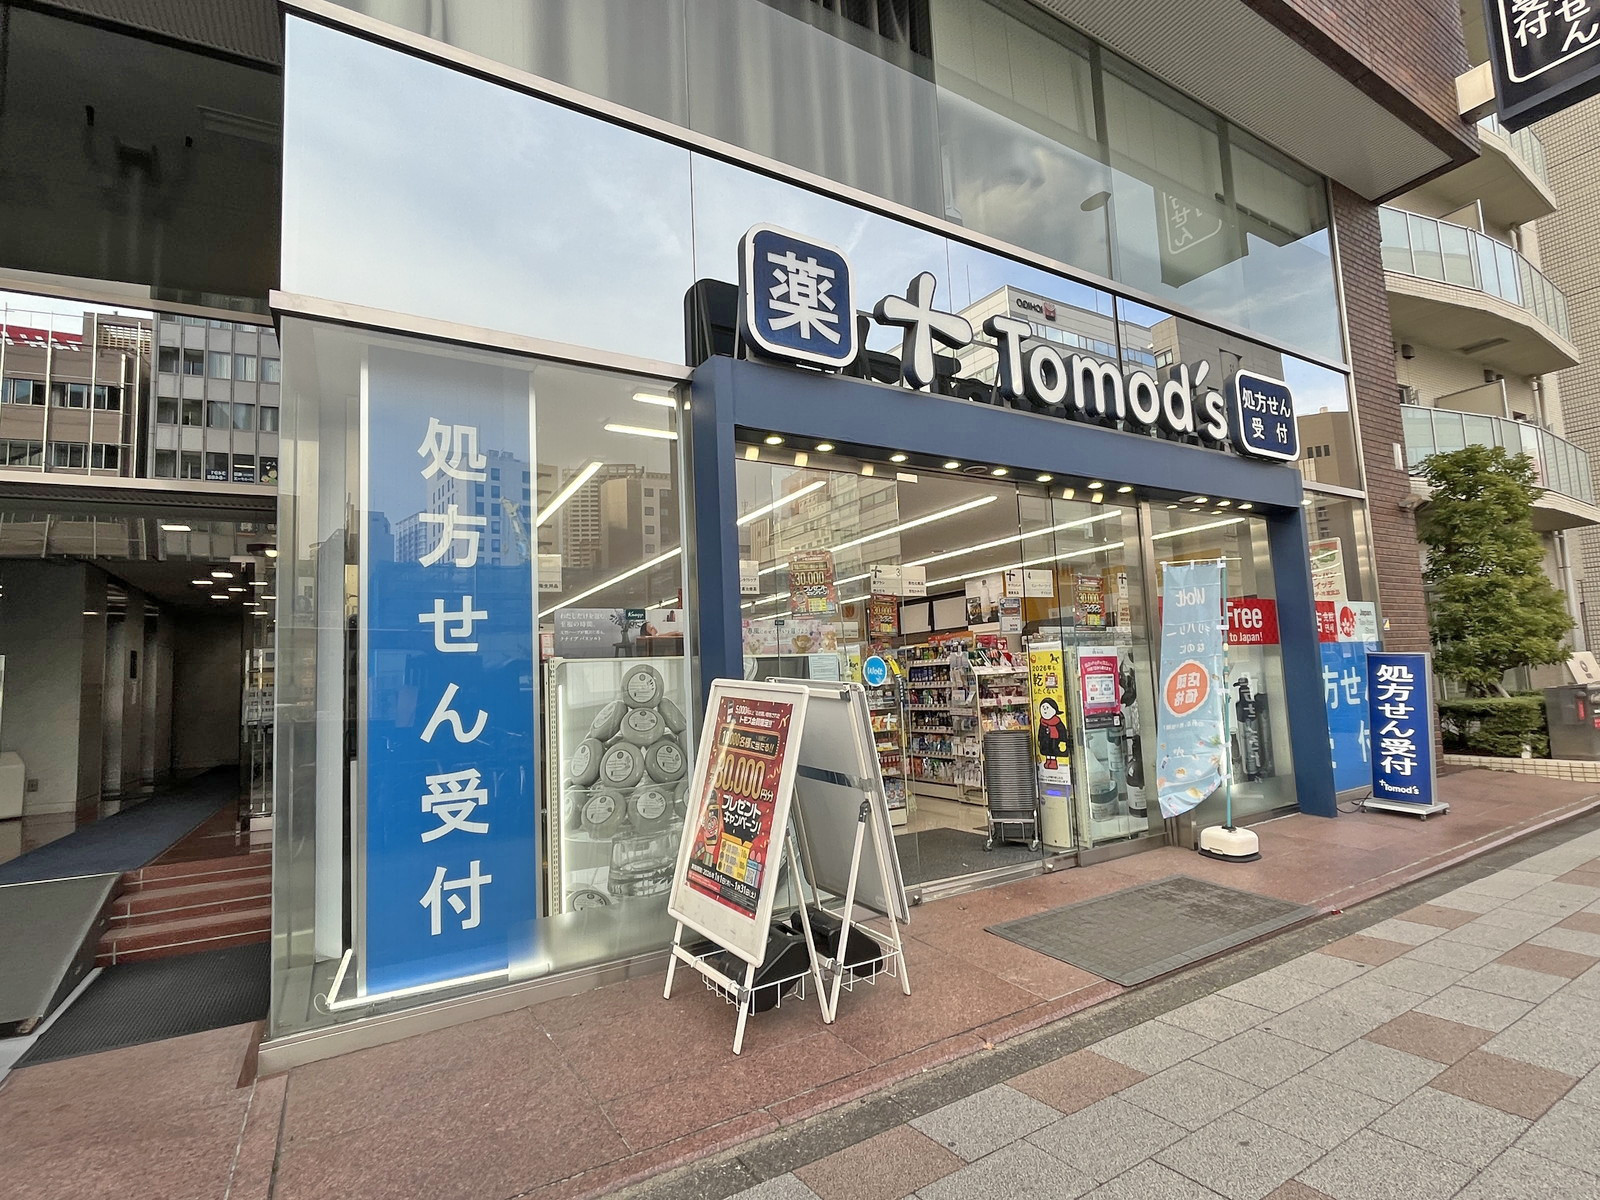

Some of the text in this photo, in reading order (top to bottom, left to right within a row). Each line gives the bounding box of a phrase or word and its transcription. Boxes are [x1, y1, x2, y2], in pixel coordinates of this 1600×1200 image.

[767, 250, 842, 345] 薬
[990, 316, 1228, 443] Tomod's
[1242, 387, 1291, 418] 処方せん
[1239, 632, 1263, 643] Japan!
[417, 416, 493, 937] 処方せん受付
[1376, 664, 1418, 776] 処方せん受付
[722, 795, 762, 819] プレゼント
[723, 811, 762, 835] キャンペーン!
